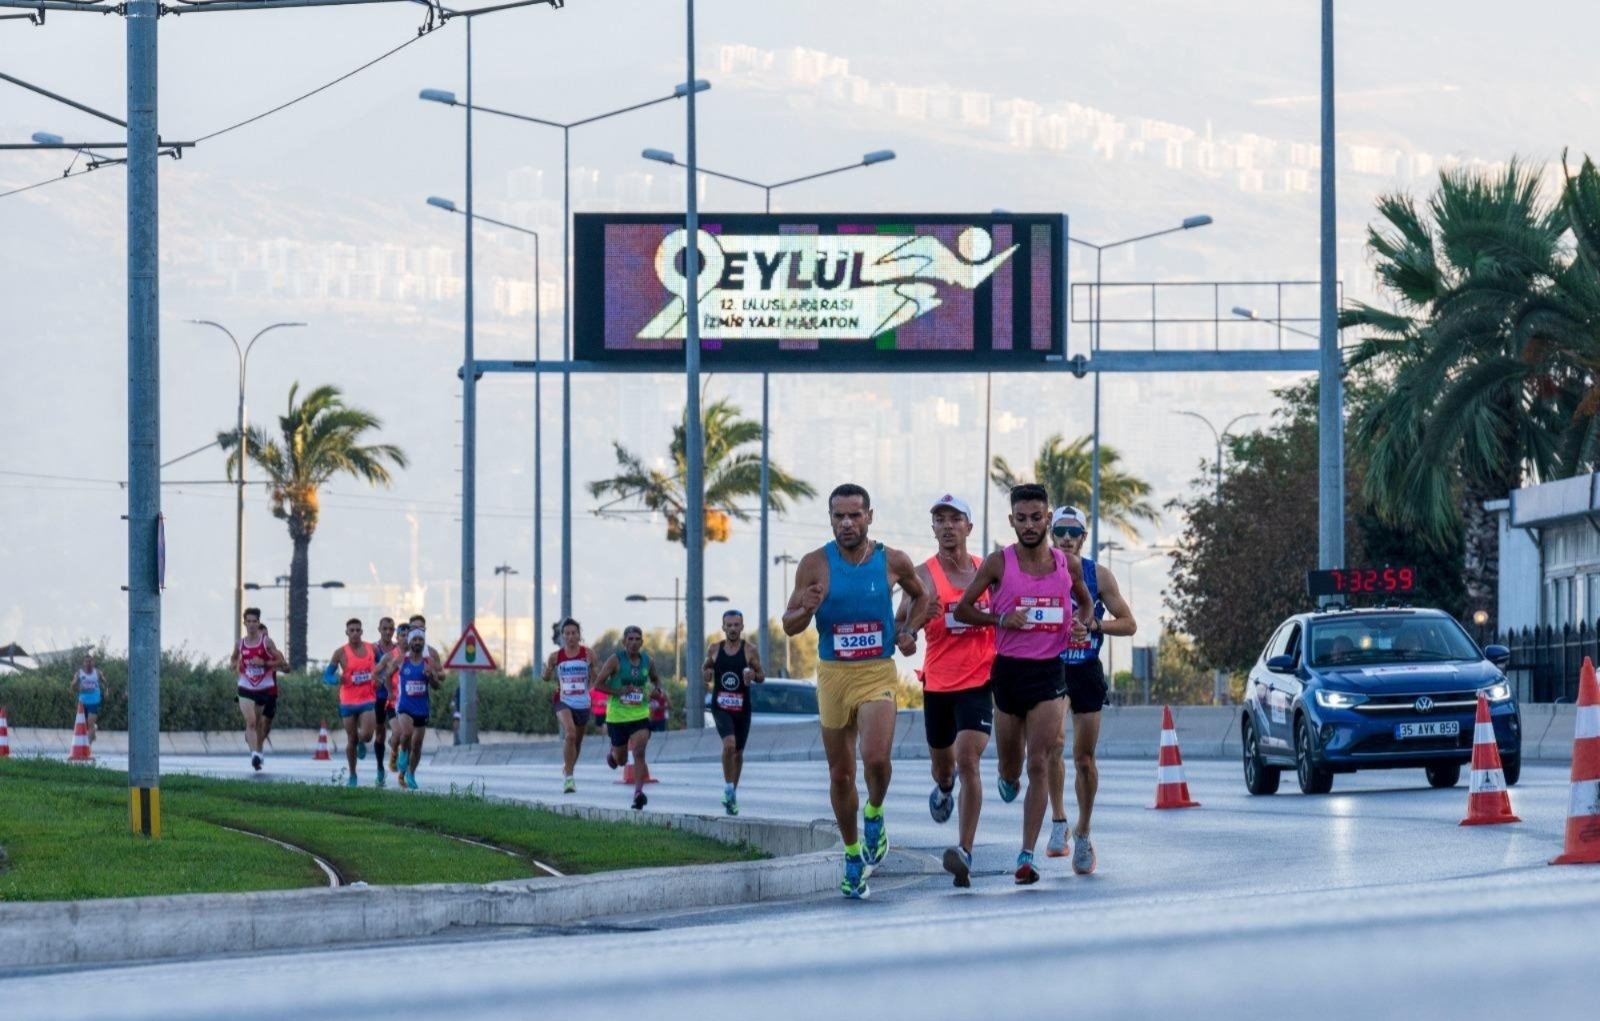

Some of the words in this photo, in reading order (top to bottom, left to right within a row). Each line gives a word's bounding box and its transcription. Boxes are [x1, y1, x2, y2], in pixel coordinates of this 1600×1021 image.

[716, 251, 876, 291] EYLÜL
[1034, 609, 1044, 621] 8
[840, 634, 876, 648] 3286
[1401, 724, 1413, 736] 35
[1418, 723, 1436, 735] AVK
[1439, 722, 1458, 734] 859
